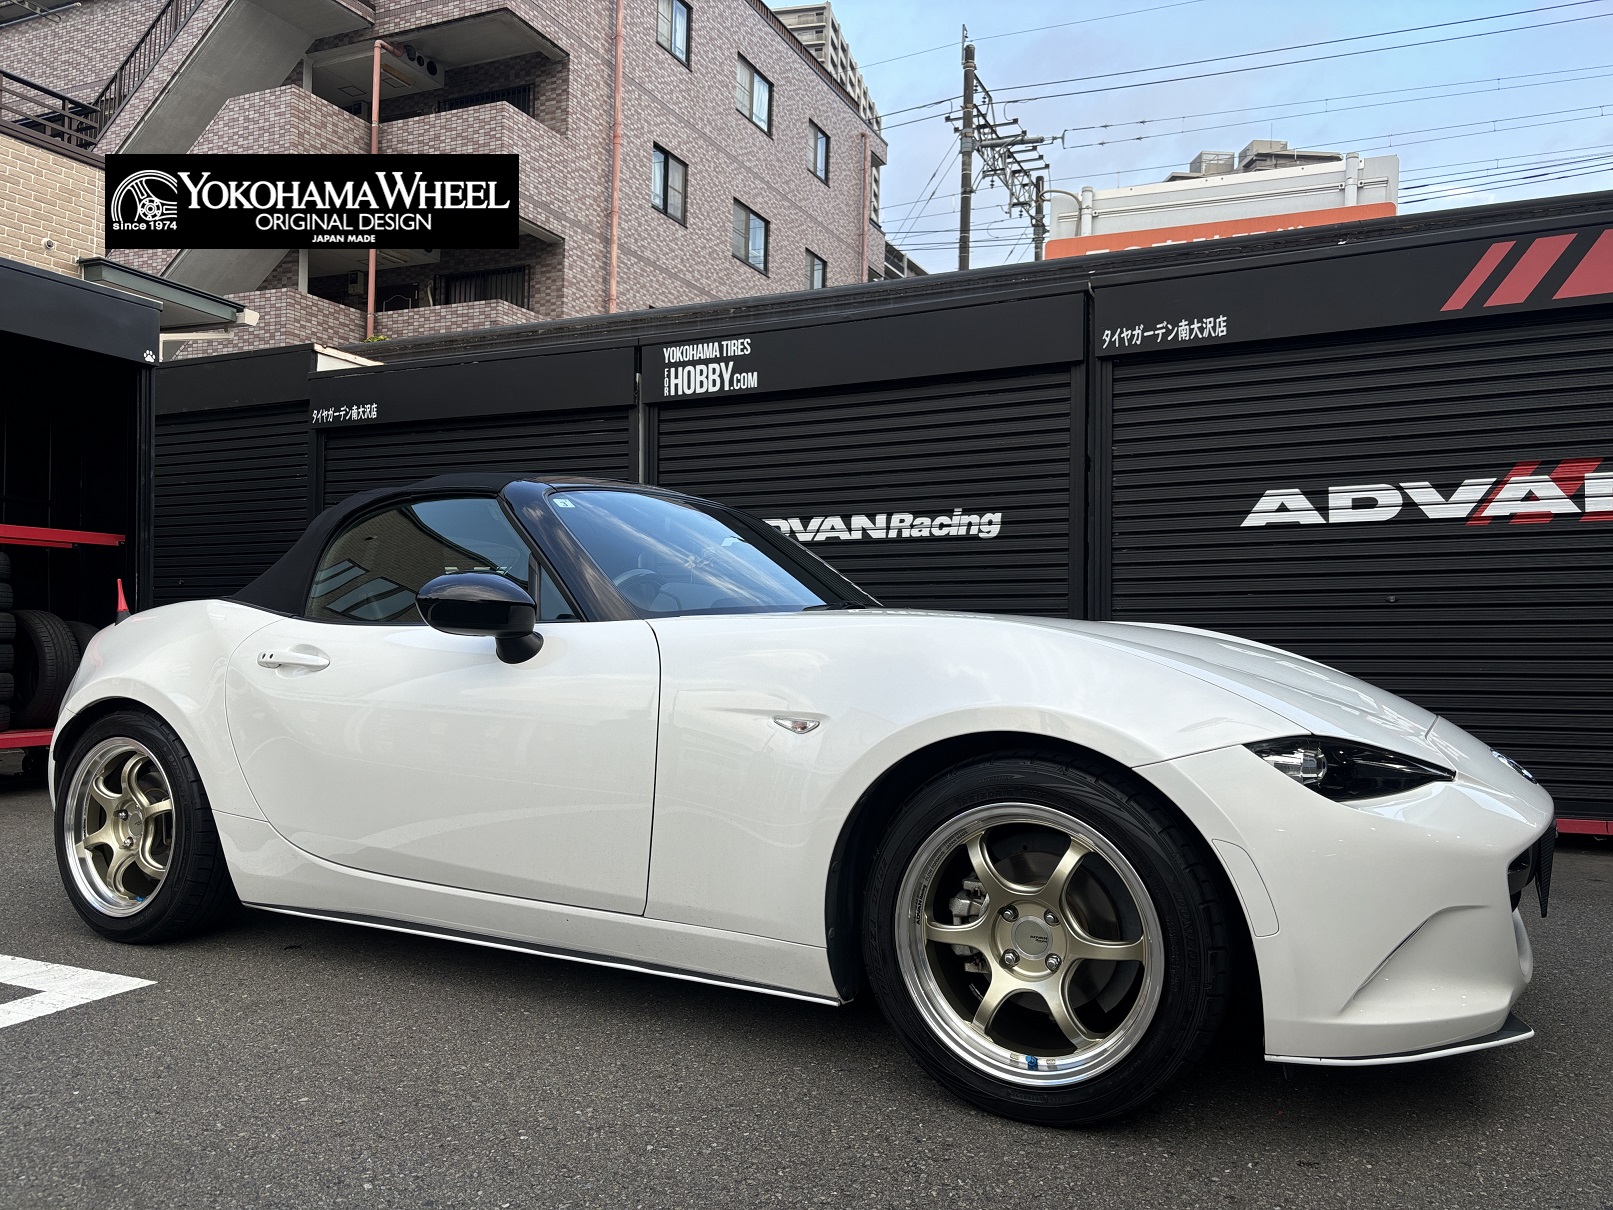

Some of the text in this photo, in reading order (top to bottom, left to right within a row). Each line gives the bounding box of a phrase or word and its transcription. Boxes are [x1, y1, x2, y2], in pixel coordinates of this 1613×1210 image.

[1102, 315, 1227, 349] タイヤガーデン南大沢店
[663, 338, 751, 363] YOKOHAMA TIRES
[312, 403, 377, 424] タイヤガーデン南大沢店
[761, 508, 1002, 542] DVAN Racing
